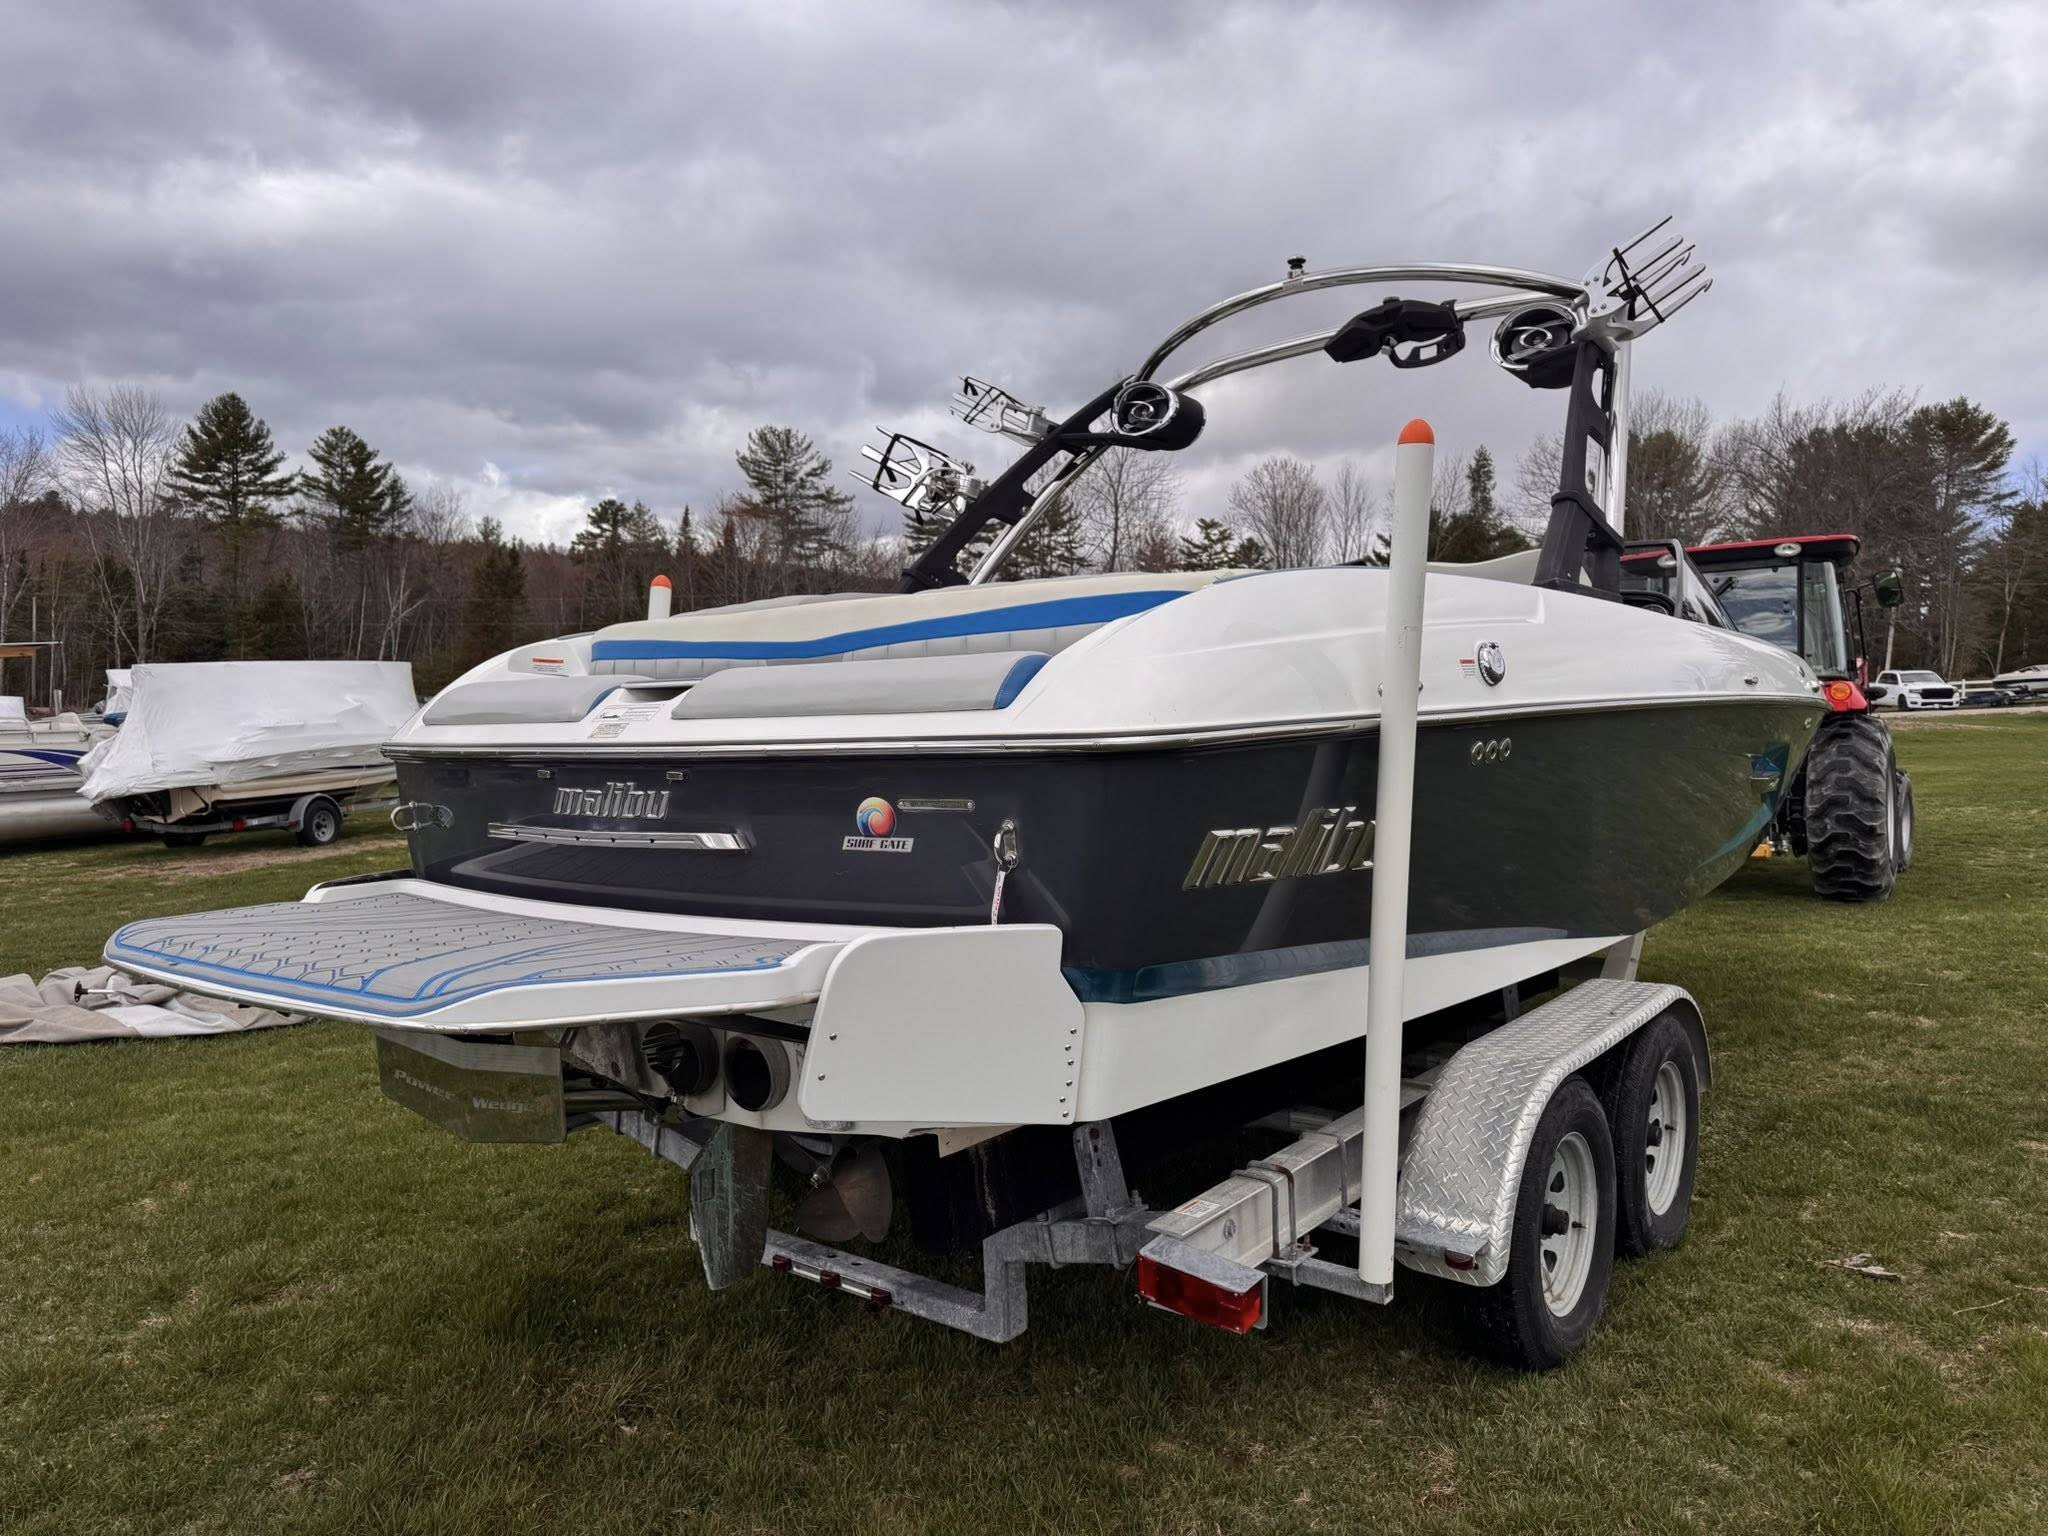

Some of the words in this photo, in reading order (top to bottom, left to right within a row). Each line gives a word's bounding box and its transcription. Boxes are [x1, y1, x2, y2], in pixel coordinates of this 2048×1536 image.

[553, 781, 671, 820] malibu
[847, 838, 877, 849] SURF
[880, 839, 910, 850] GATE
